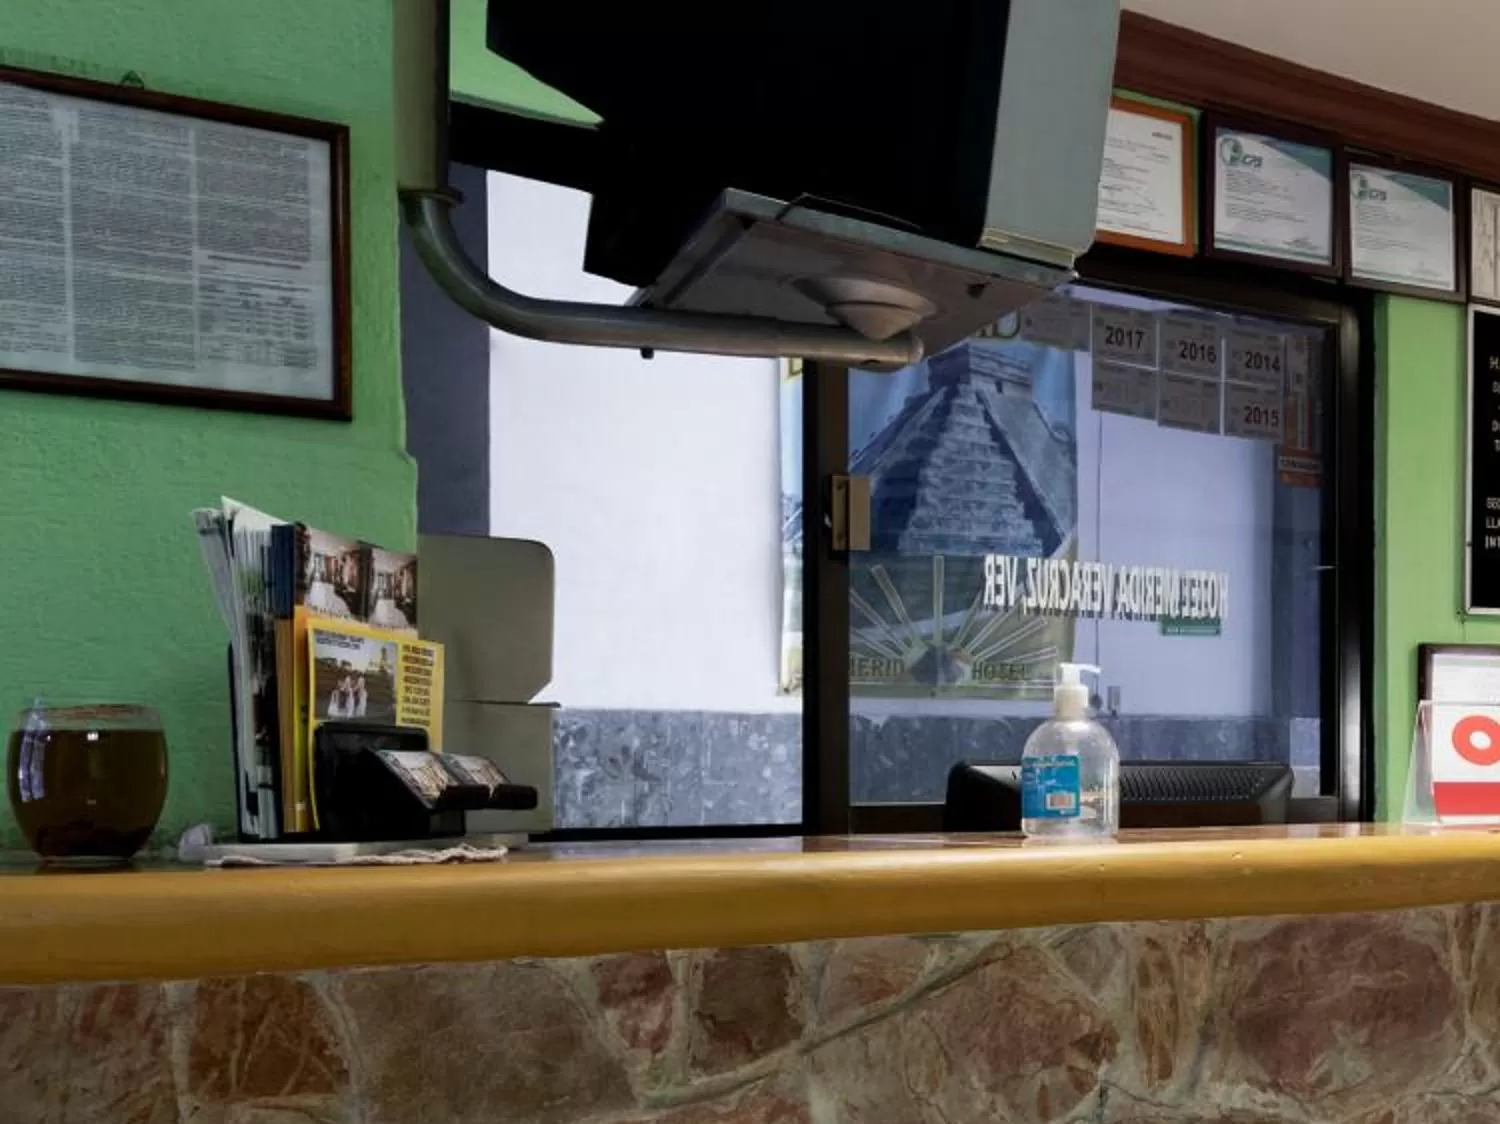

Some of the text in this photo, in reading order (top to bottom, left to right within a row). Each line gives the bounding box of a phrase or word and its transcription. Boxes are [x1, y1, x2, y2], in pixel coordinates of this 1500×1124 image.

[1105, 325, 1144, 350] 2017
[1178, 339, 1217, 364] 2016
[1245, 351, 1281, 373] 2014
[1243, 405, 1279, 428] 2015
